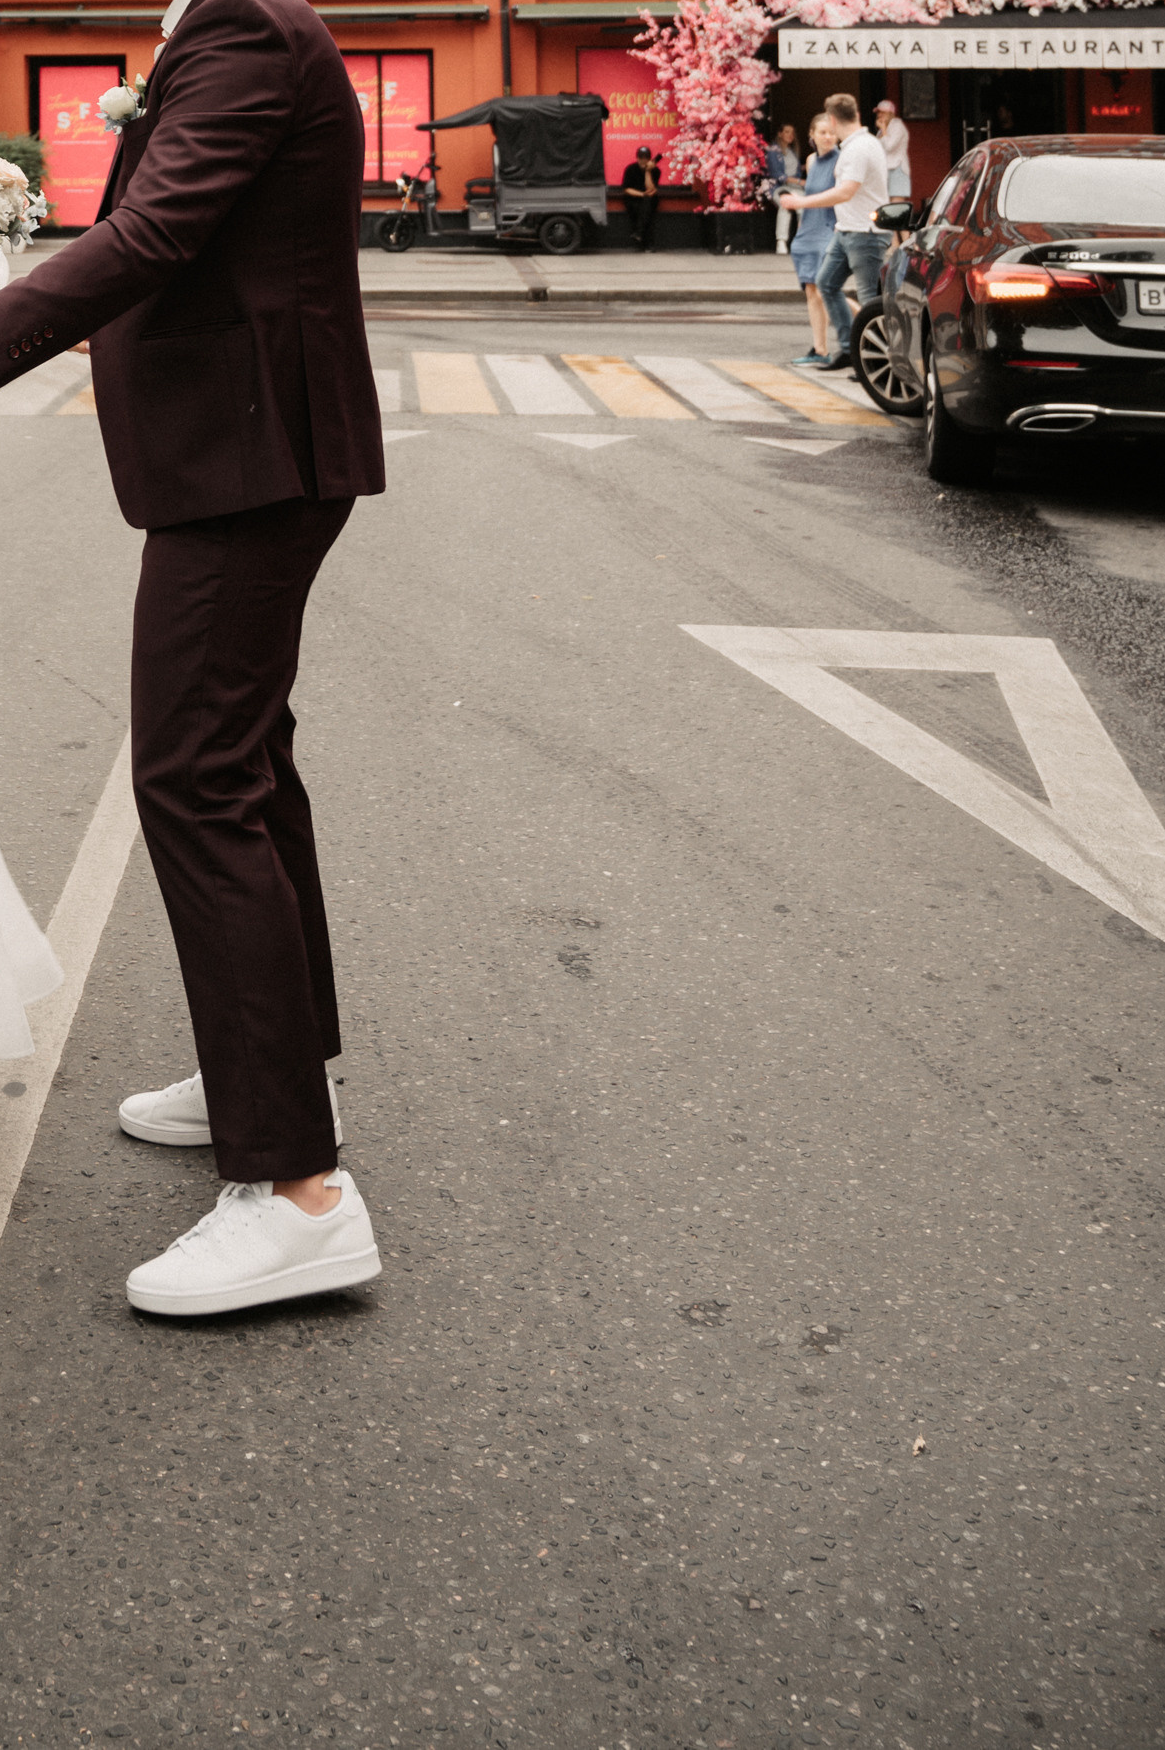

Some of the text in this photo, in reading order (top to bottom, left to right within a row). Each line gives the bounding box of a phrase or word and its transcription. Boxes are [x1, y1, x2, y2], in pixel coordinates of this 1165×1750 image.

[788, 40, 1165, 55] IZAKAYA RESTAURANT
[605, 112, 678, 128] ТКРЫТИЕ
